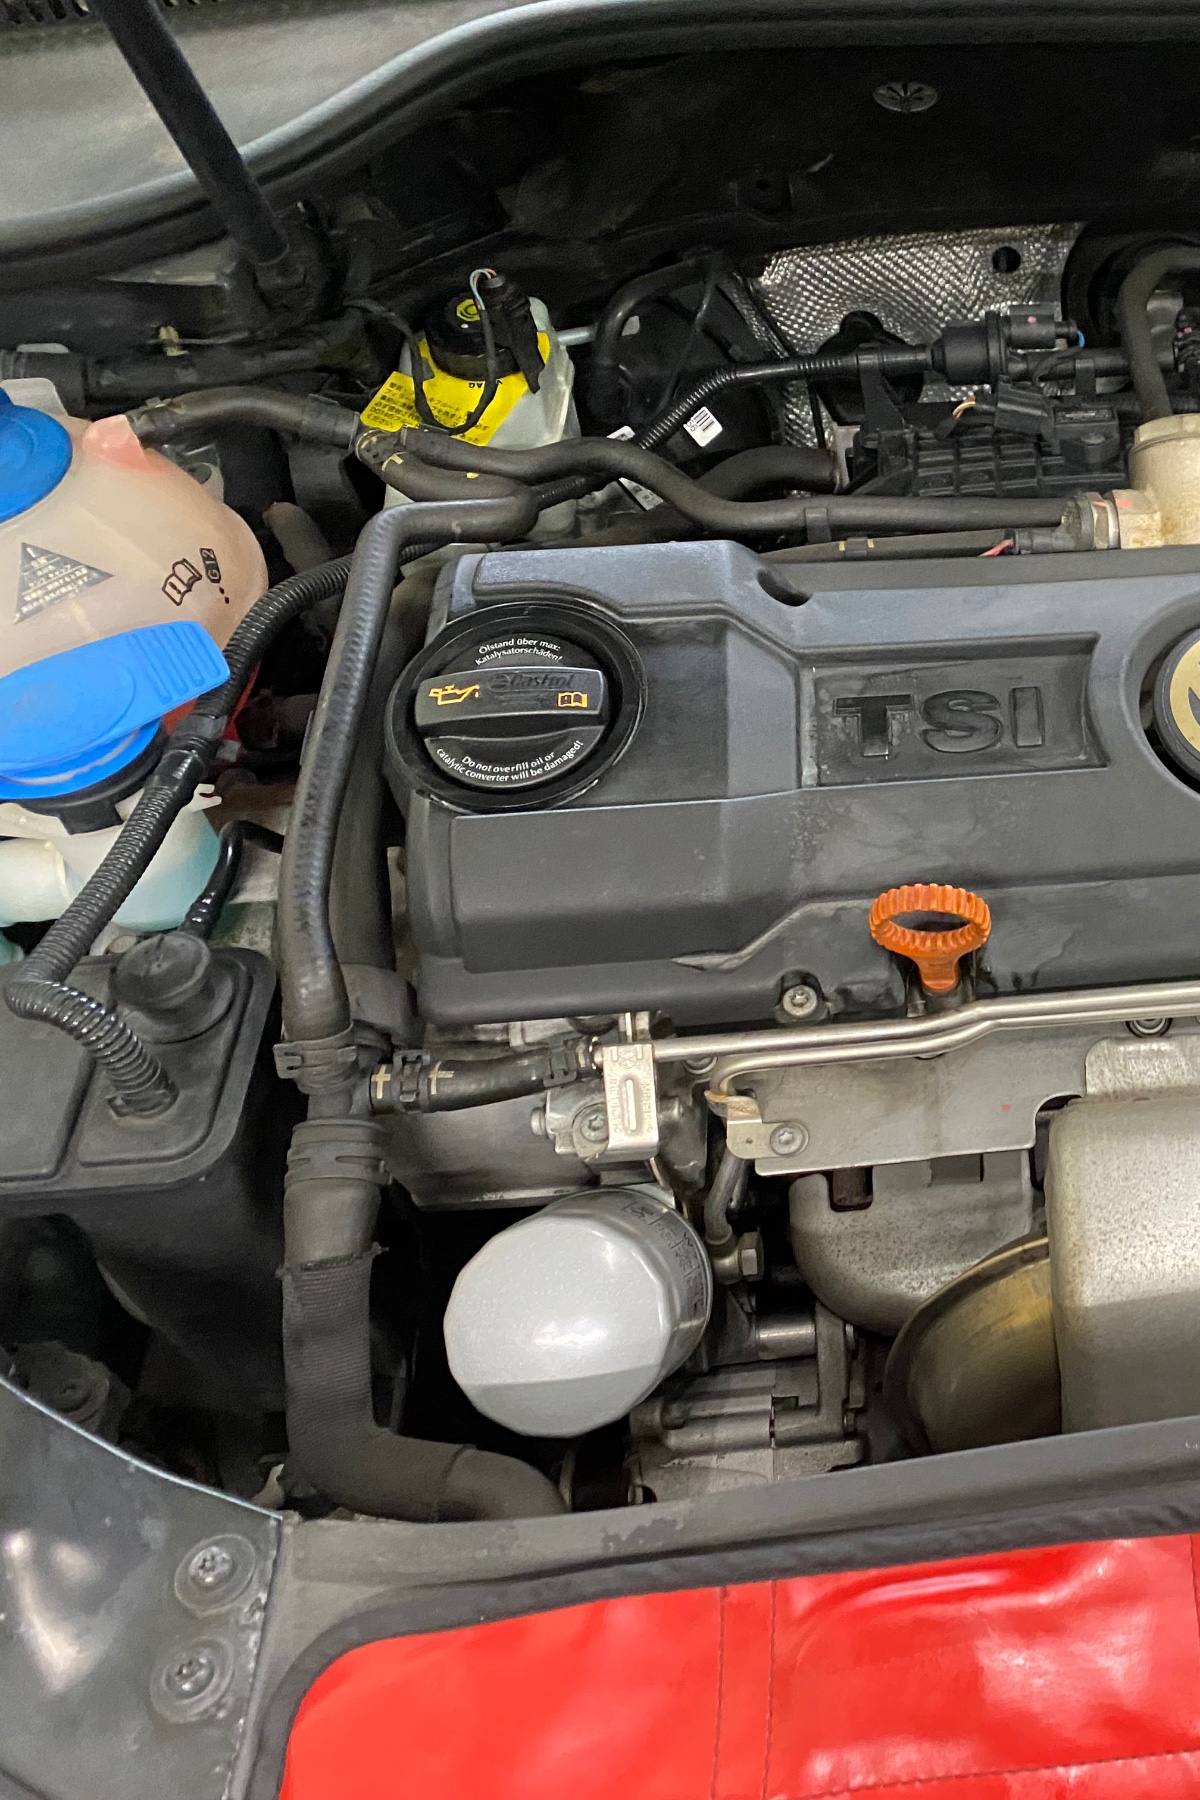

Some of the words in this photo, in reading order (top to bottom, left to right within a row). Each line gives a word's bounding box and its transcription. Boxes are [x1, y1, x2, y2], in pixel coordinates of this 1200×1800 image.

[201, 549, 220, 580] G12
[479, 638, 515, 655] Ölstand
[517, 637, 538, 646] über
[510, 673, 575, 688] Castrol
[832, 686, 1046, 758] TSI
[436, 748, 466, 773] catalytic
[464, 769, 509, 782] converter
[510, 770, 530, 781] will
[530, 766, 544, 776] be
[544, 740, 584, 771] damaged!
[461, 755, 475, 768] Do
[476, 763, 493, 772] not
[493, 761, 529, 773] overfill
[530, 756, 544, 768] oil
[545, 751, 556, 762] or
